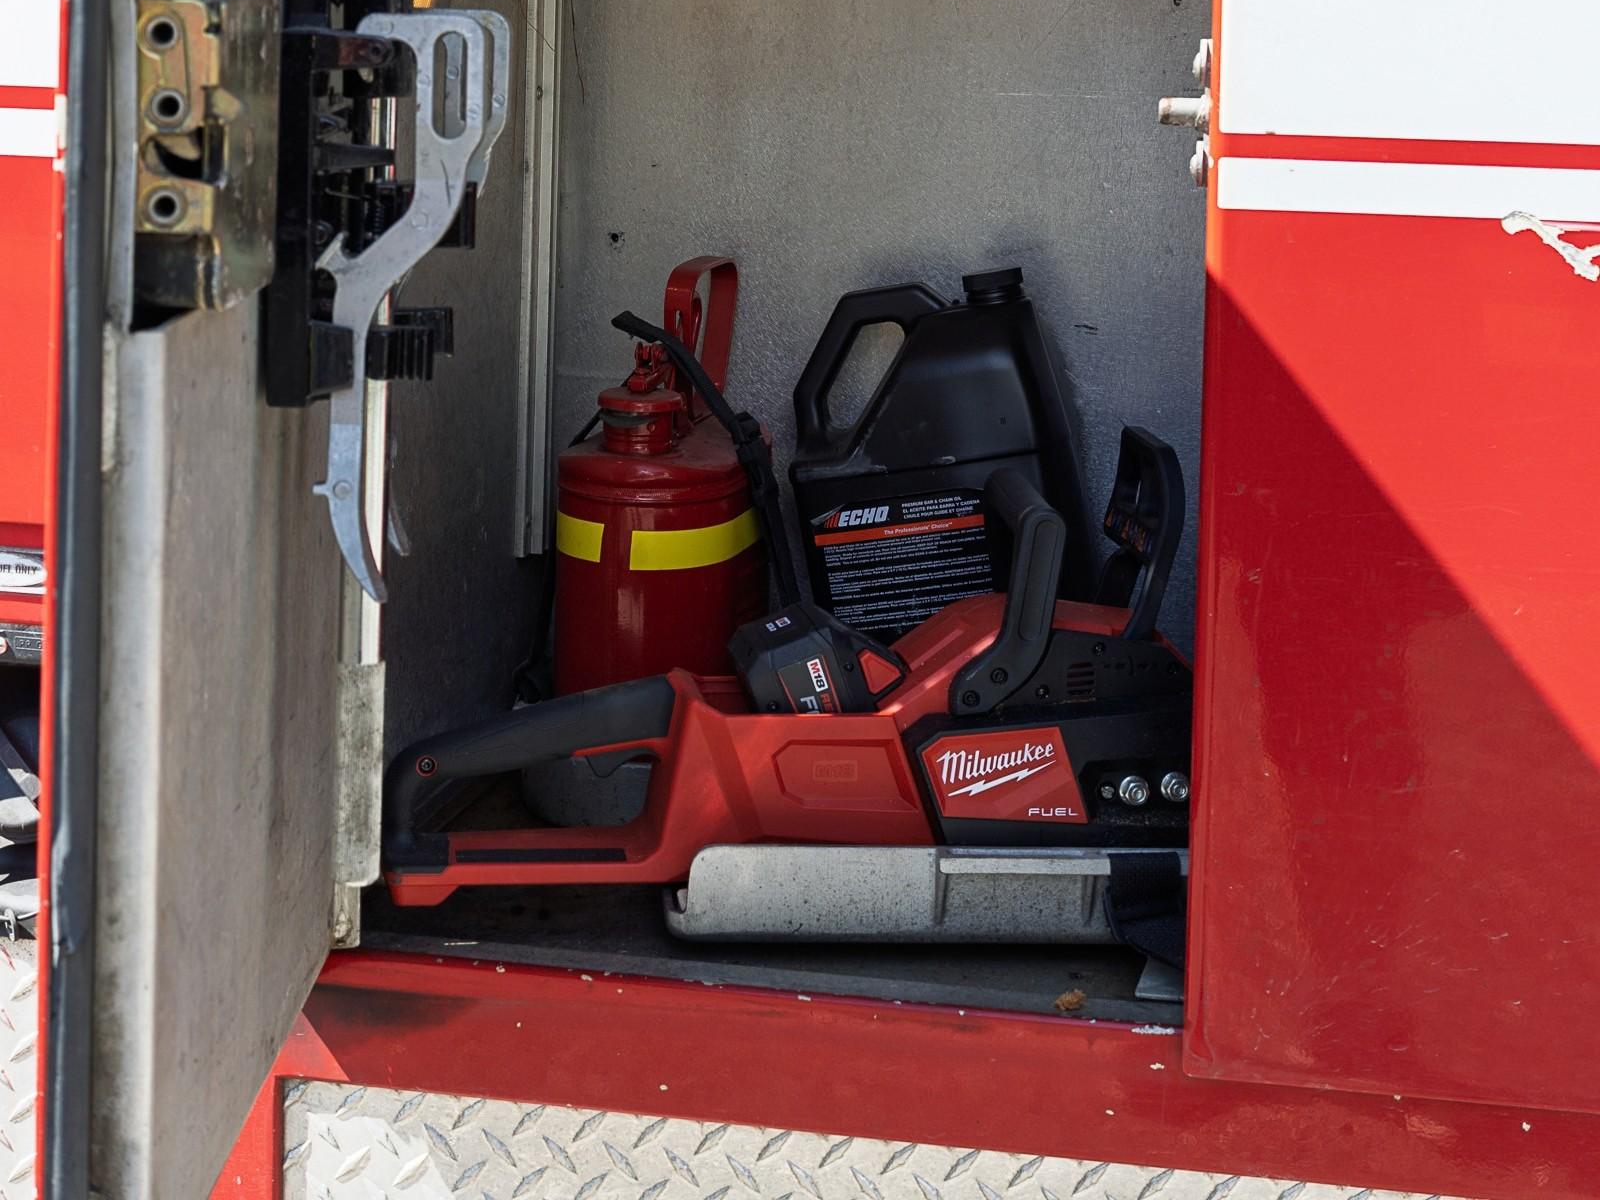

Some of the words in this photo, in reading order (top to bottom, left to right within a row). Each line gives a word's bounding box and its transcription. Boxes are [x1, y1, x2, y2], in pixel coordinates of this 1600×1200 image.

[838, 506, 889, 527] ECHO
[809, 661, 826, 690] M18
[936, 743, 1055, 785] Milwaukee
[1028, 807, 1079, 817] FUEL
